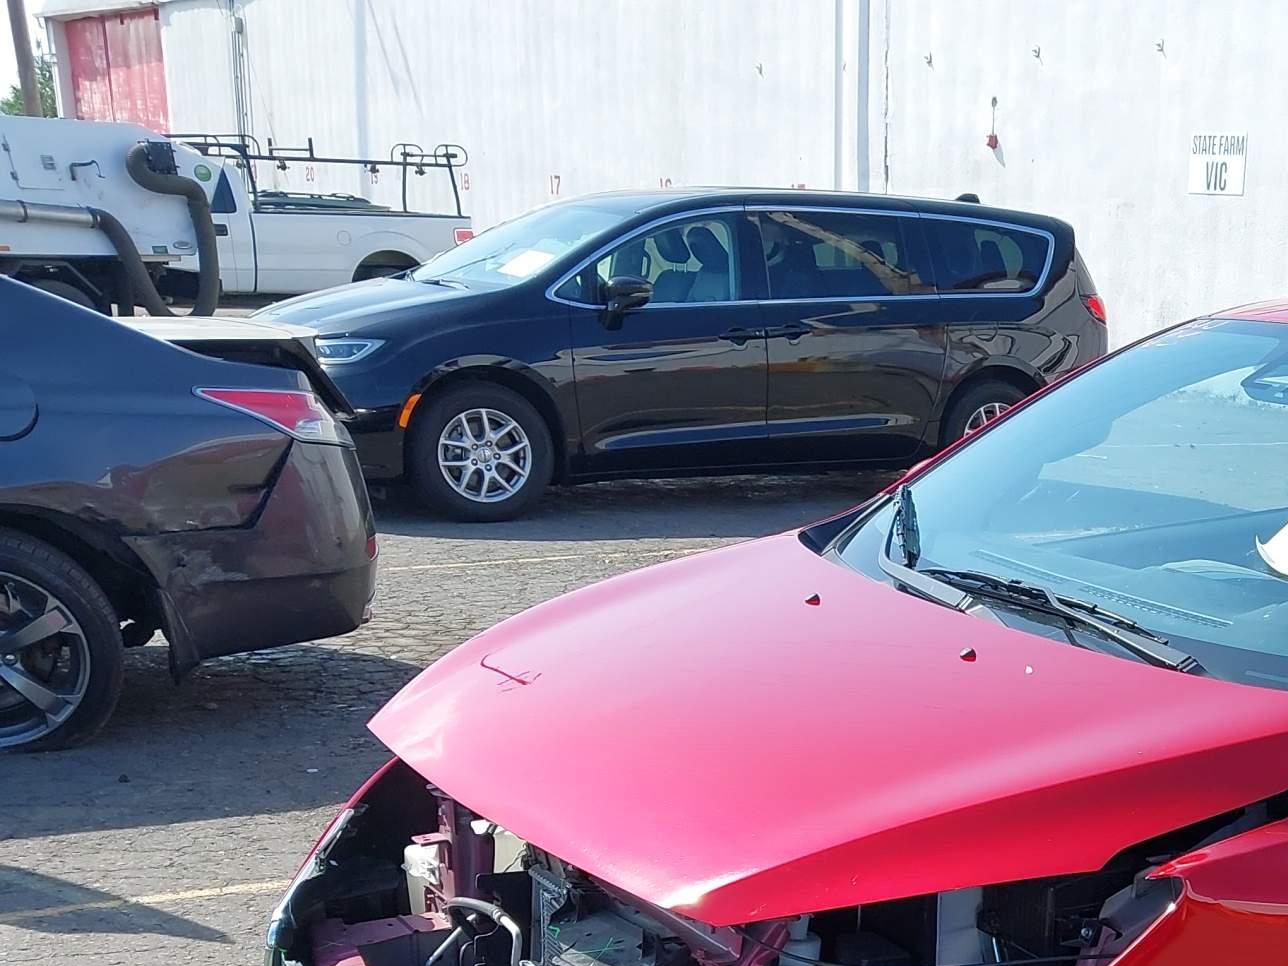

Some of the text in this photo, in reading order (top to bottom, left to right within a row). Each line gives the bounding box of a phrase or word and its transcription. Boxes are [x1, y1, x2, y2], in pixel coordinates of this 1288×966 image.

[1192, 135, 1245, 156] STATE FARM
[305, 166, 315, 182] 20
[460, 172, 471, 191] 18
[1206, 161, 1228, 191] VIC
[550, 175, 560, 195] 17
